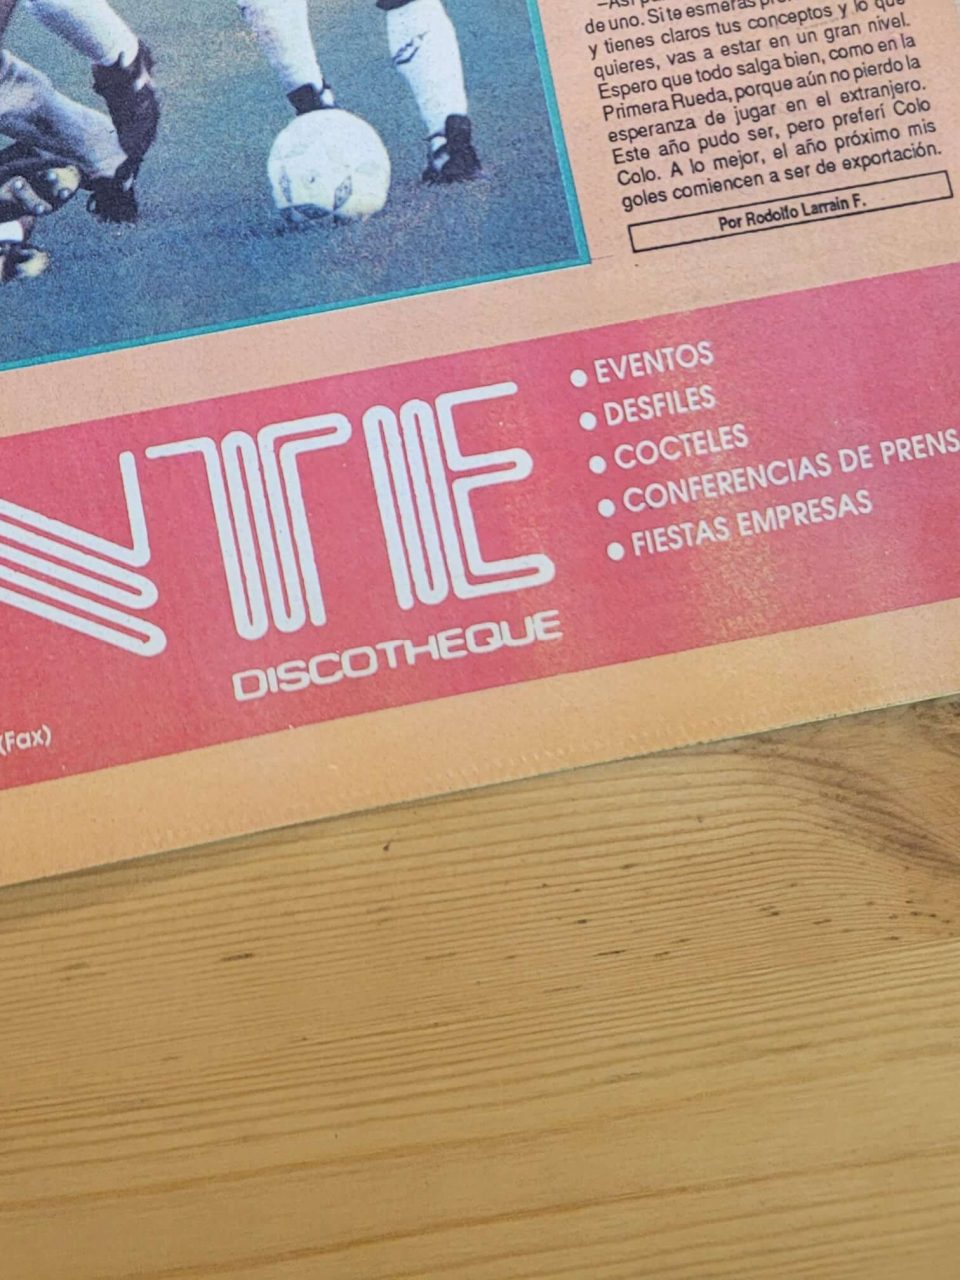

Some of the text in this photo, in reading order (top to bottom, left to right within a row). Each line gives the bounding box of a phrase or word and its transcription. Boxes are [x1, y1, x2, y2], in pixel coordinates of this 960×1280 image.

[621, 145, 942, 211] goles comiencen a ser de exportación.
[718, 215, 742, 231] Por
[746, 207, 799, 227] Rodolfo
[853, 194, 866, 208] F.
[594, 341, 714, 383] EVENTOS
[604, 385, 716, 426] DESFILES
[614, 424, 749, 470] COCTELES
[622, 428, 960, 513] CONFERENCIAS DE PRENS
[632, 490, 872, 556] FIESTAS EMPRESAS
[231, 609, 562, 702] DISCOTHEQUE
